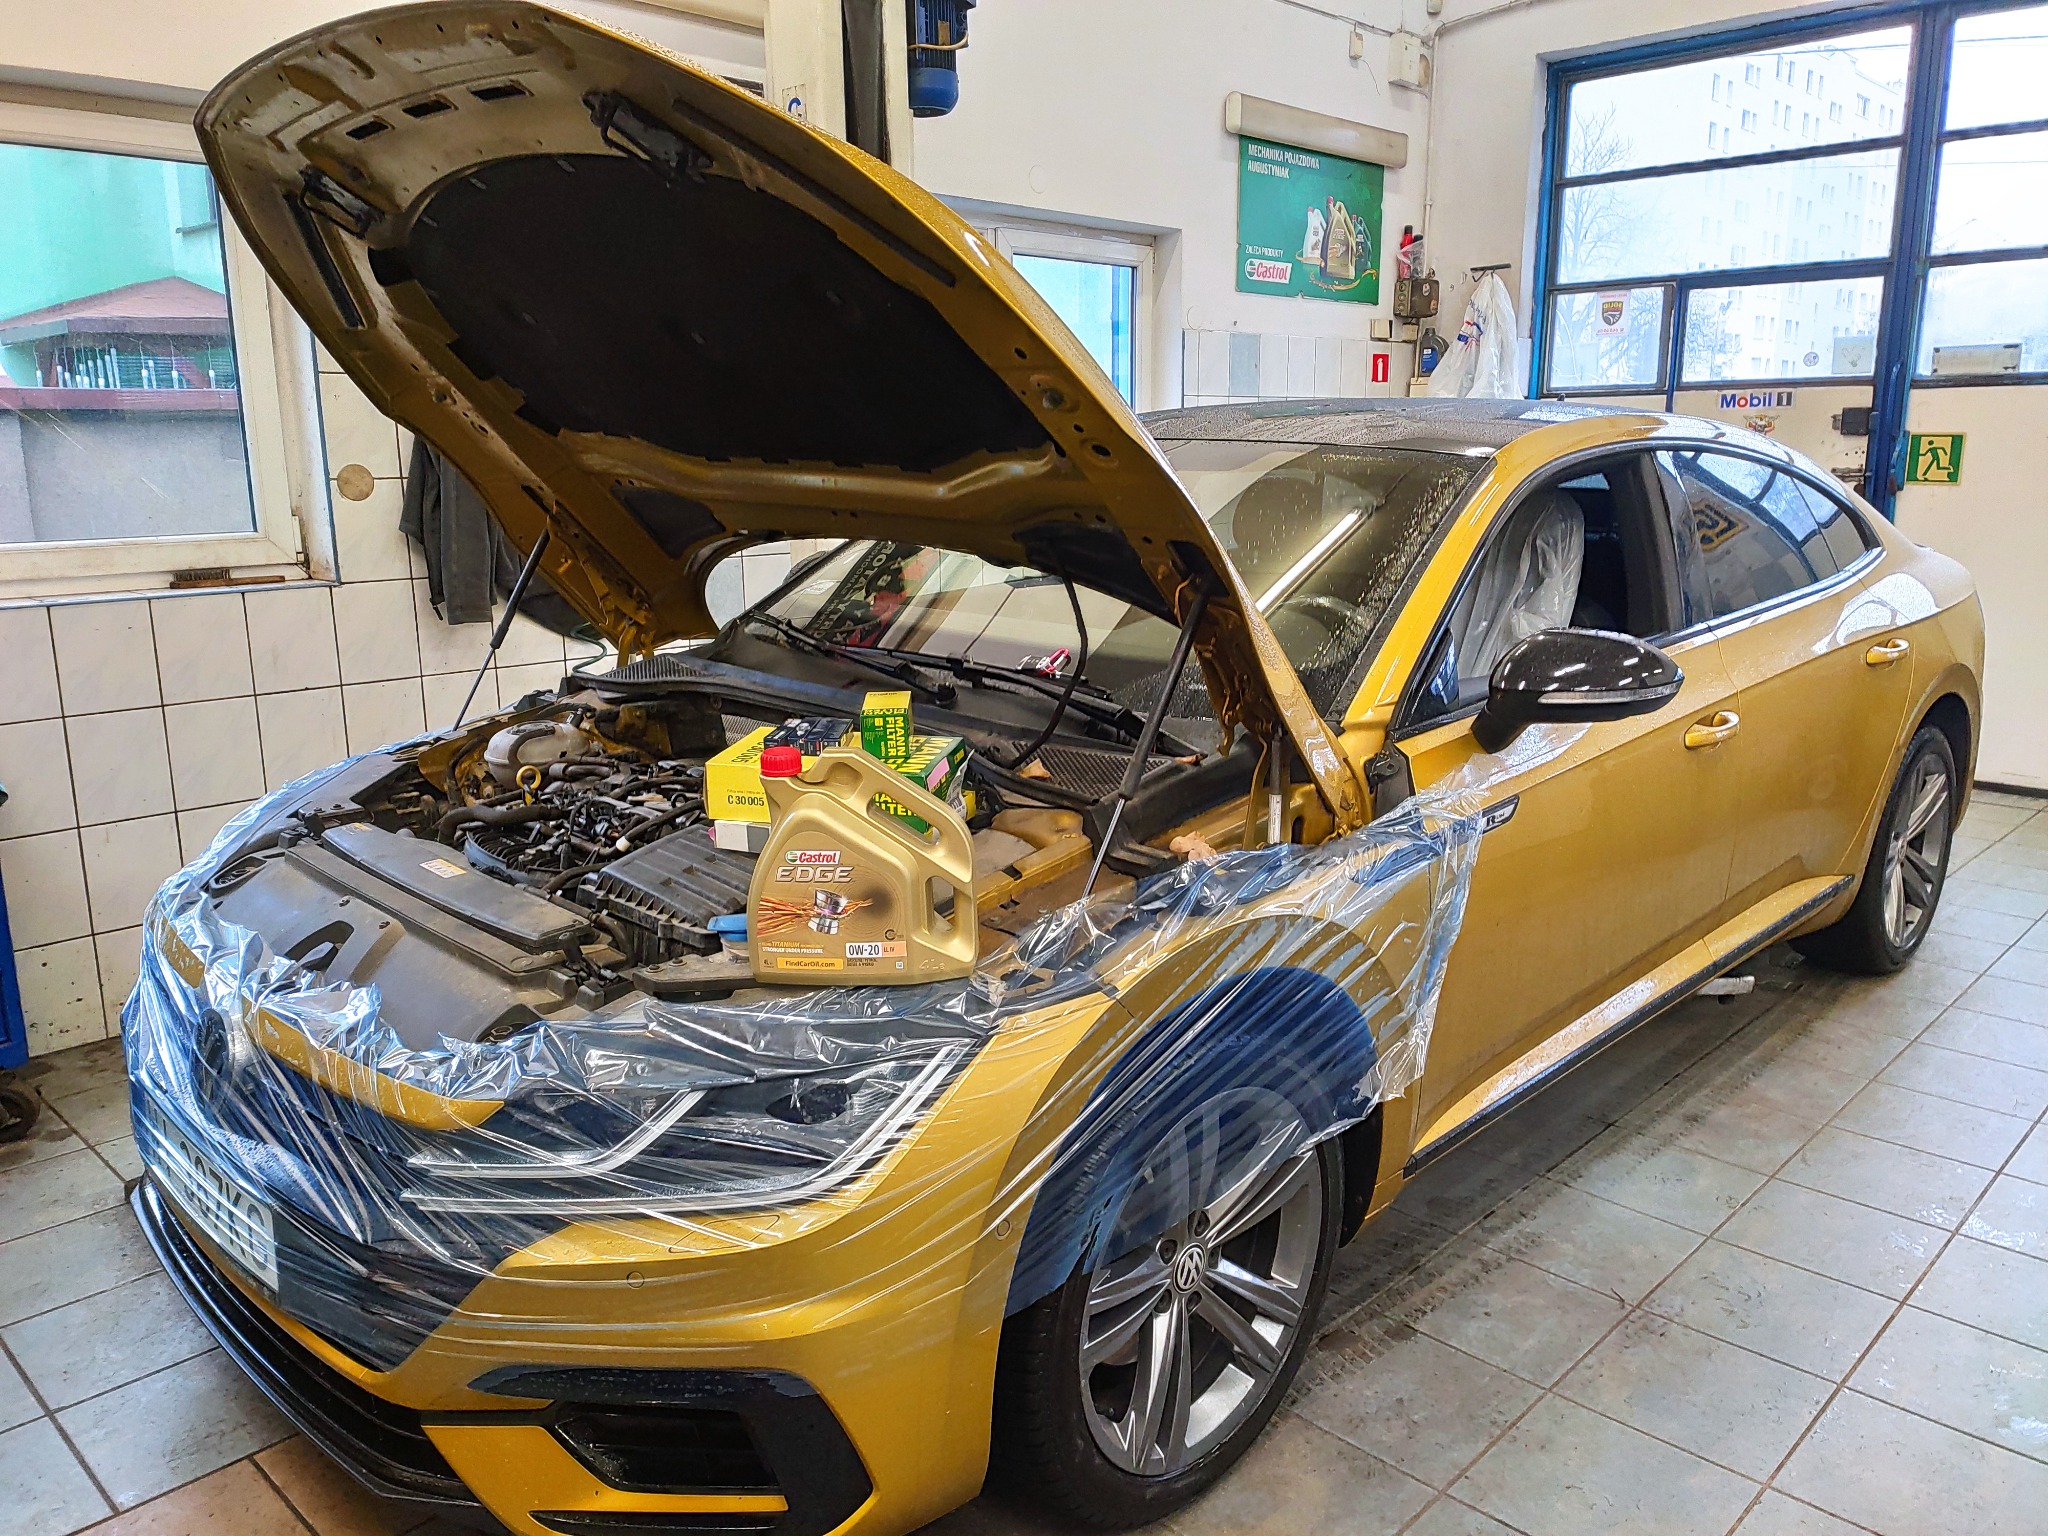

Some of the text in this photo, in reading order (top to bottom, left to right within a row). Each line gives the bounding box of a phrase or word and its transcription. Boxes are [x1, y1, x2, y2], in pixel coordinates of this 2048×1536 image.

[1248, 143, 1320, 170] MECHANIKA POJAZDOWA
[1247, 160, 1290, 179] AUGUSTYNIAK
[1256, 262, 1289, 280] Castrol
[1720, 392, 1773, 408] Mobil
[886, 717, 897, 757] FILTER
[895, 716, 906, 756] MANN
[727, 794, 765, 807] C 30 005
[798, 851, 837, 863] Castrol
[774, 865, 855, 883] EDGE
[848, 944, 880, 956] 0W-20
[785, 960, 836, 968] FindCarOil.com
